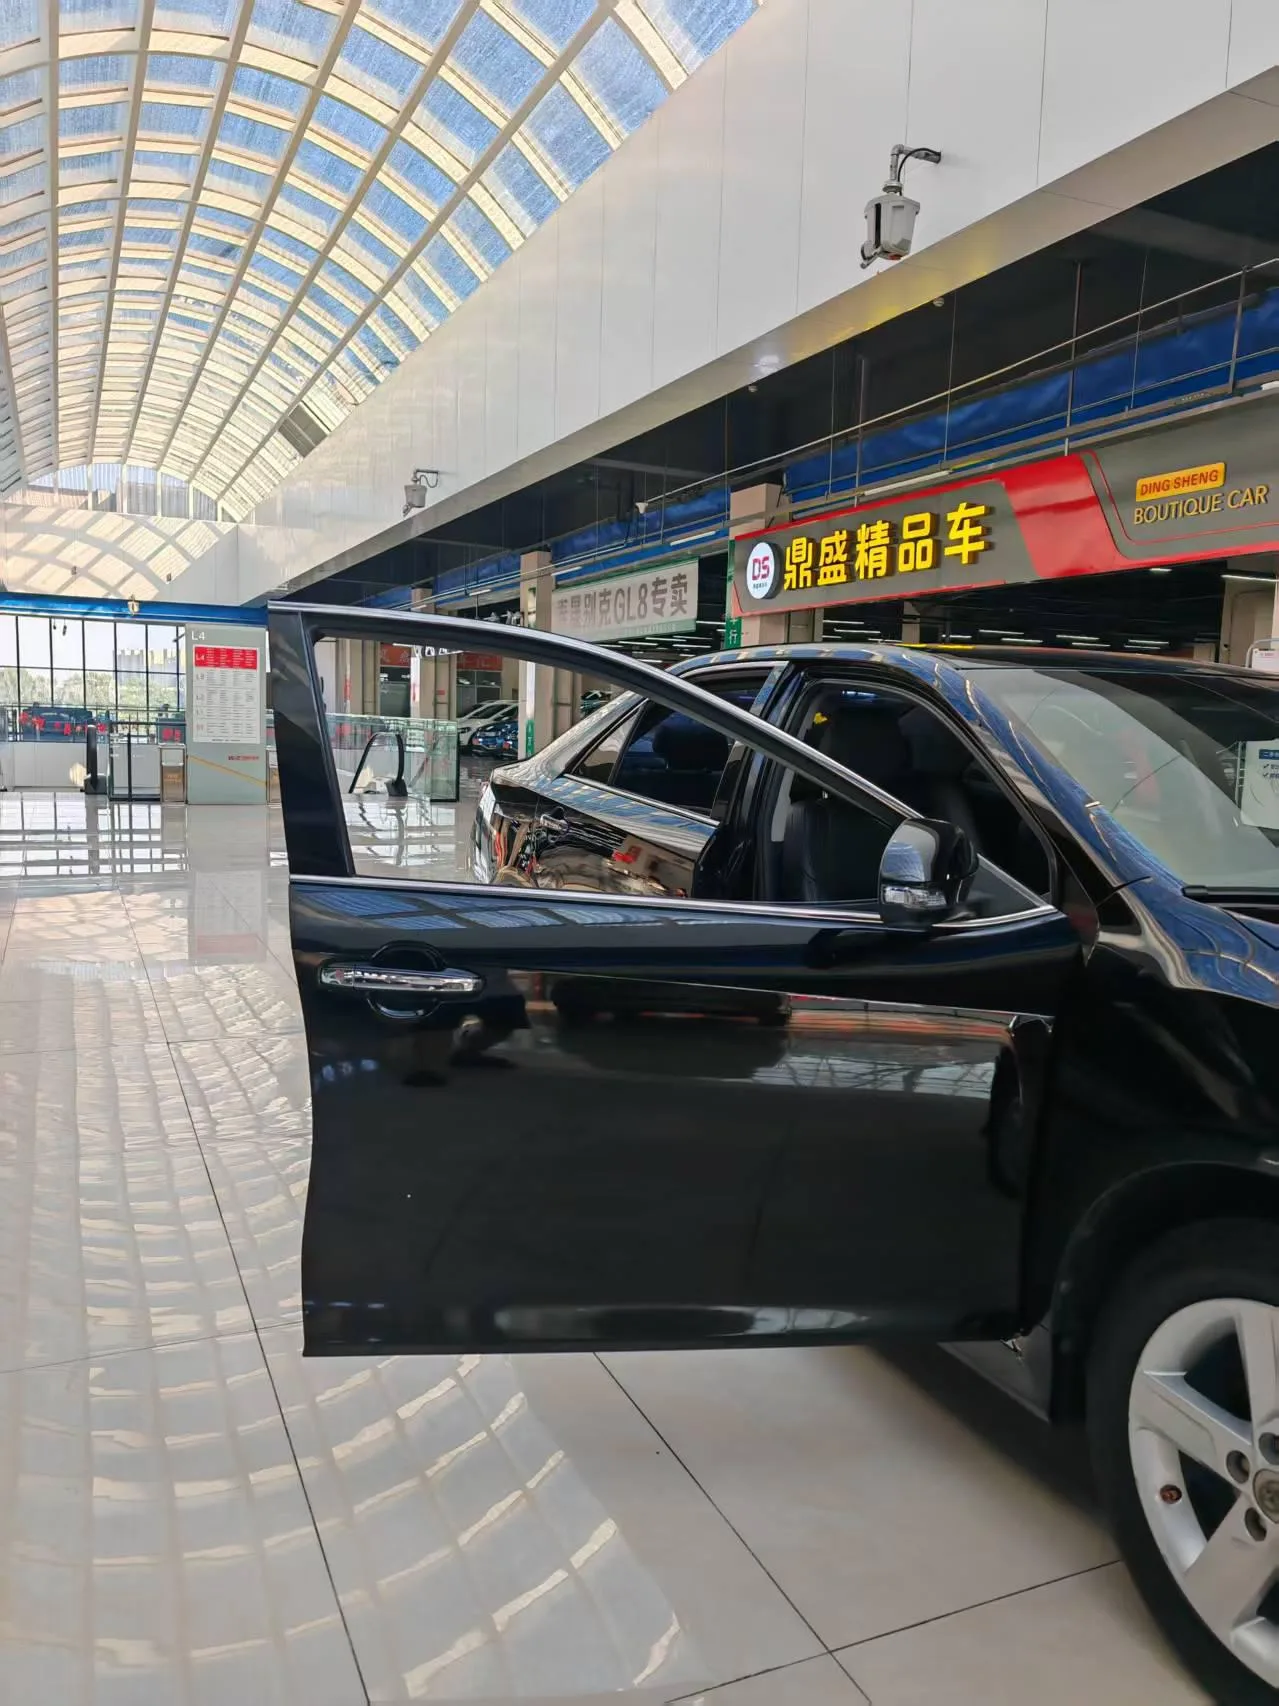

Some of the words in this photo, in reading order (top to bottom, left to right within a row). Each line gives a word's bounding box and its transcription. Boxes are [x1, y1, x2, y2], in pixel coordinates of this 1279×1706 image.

[1140, 478, 1171, 496] DING
[1173, 469, 1219, 489] SHENG
[1133, 493, 1223, 525] BOUTIQUE
[1227, 485, 1268, 509] CAR
[783, 502, 986, 590] 鼎盛精品车
[752, 555, 770, 581] DS
[191, 631, 206, 641] L4
